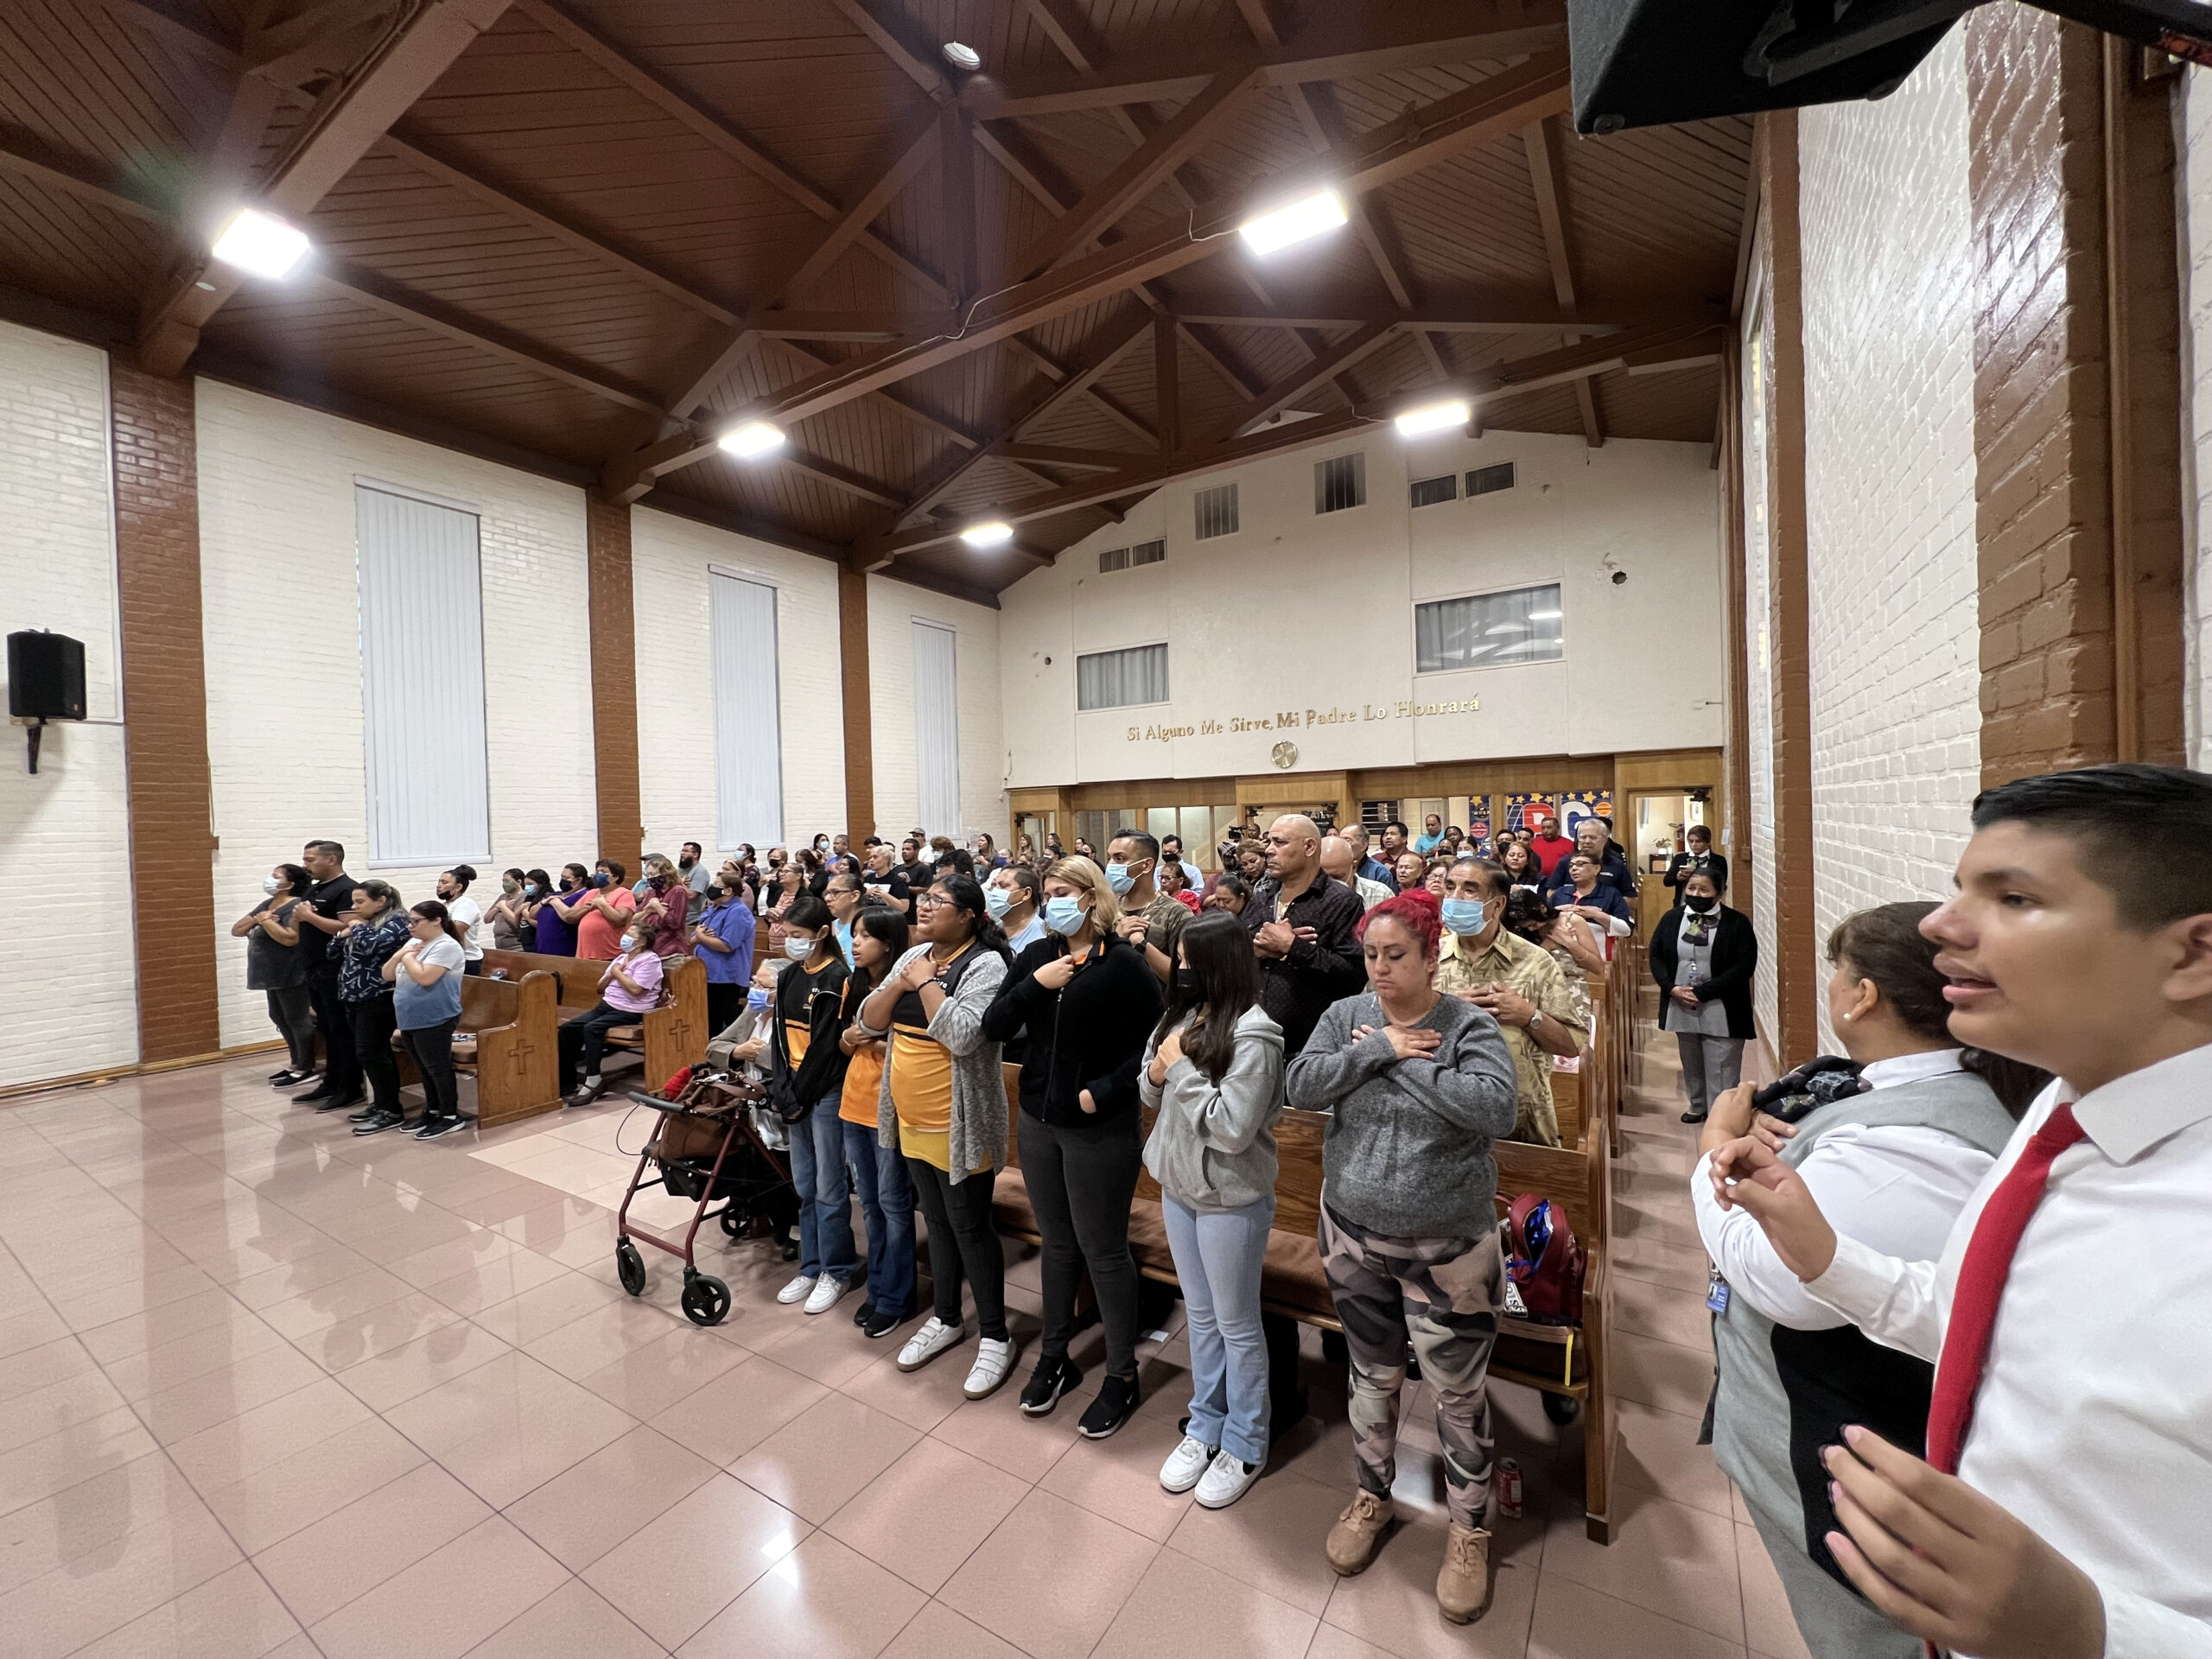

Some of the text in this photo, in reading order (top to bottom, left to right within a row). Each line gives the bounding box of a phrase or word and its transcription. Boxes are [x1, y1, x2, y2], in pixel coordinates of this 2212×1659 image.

[1127, 693, 1480, 742] Si Alguno Me Sirve, Mi Padre Lo Honrará
